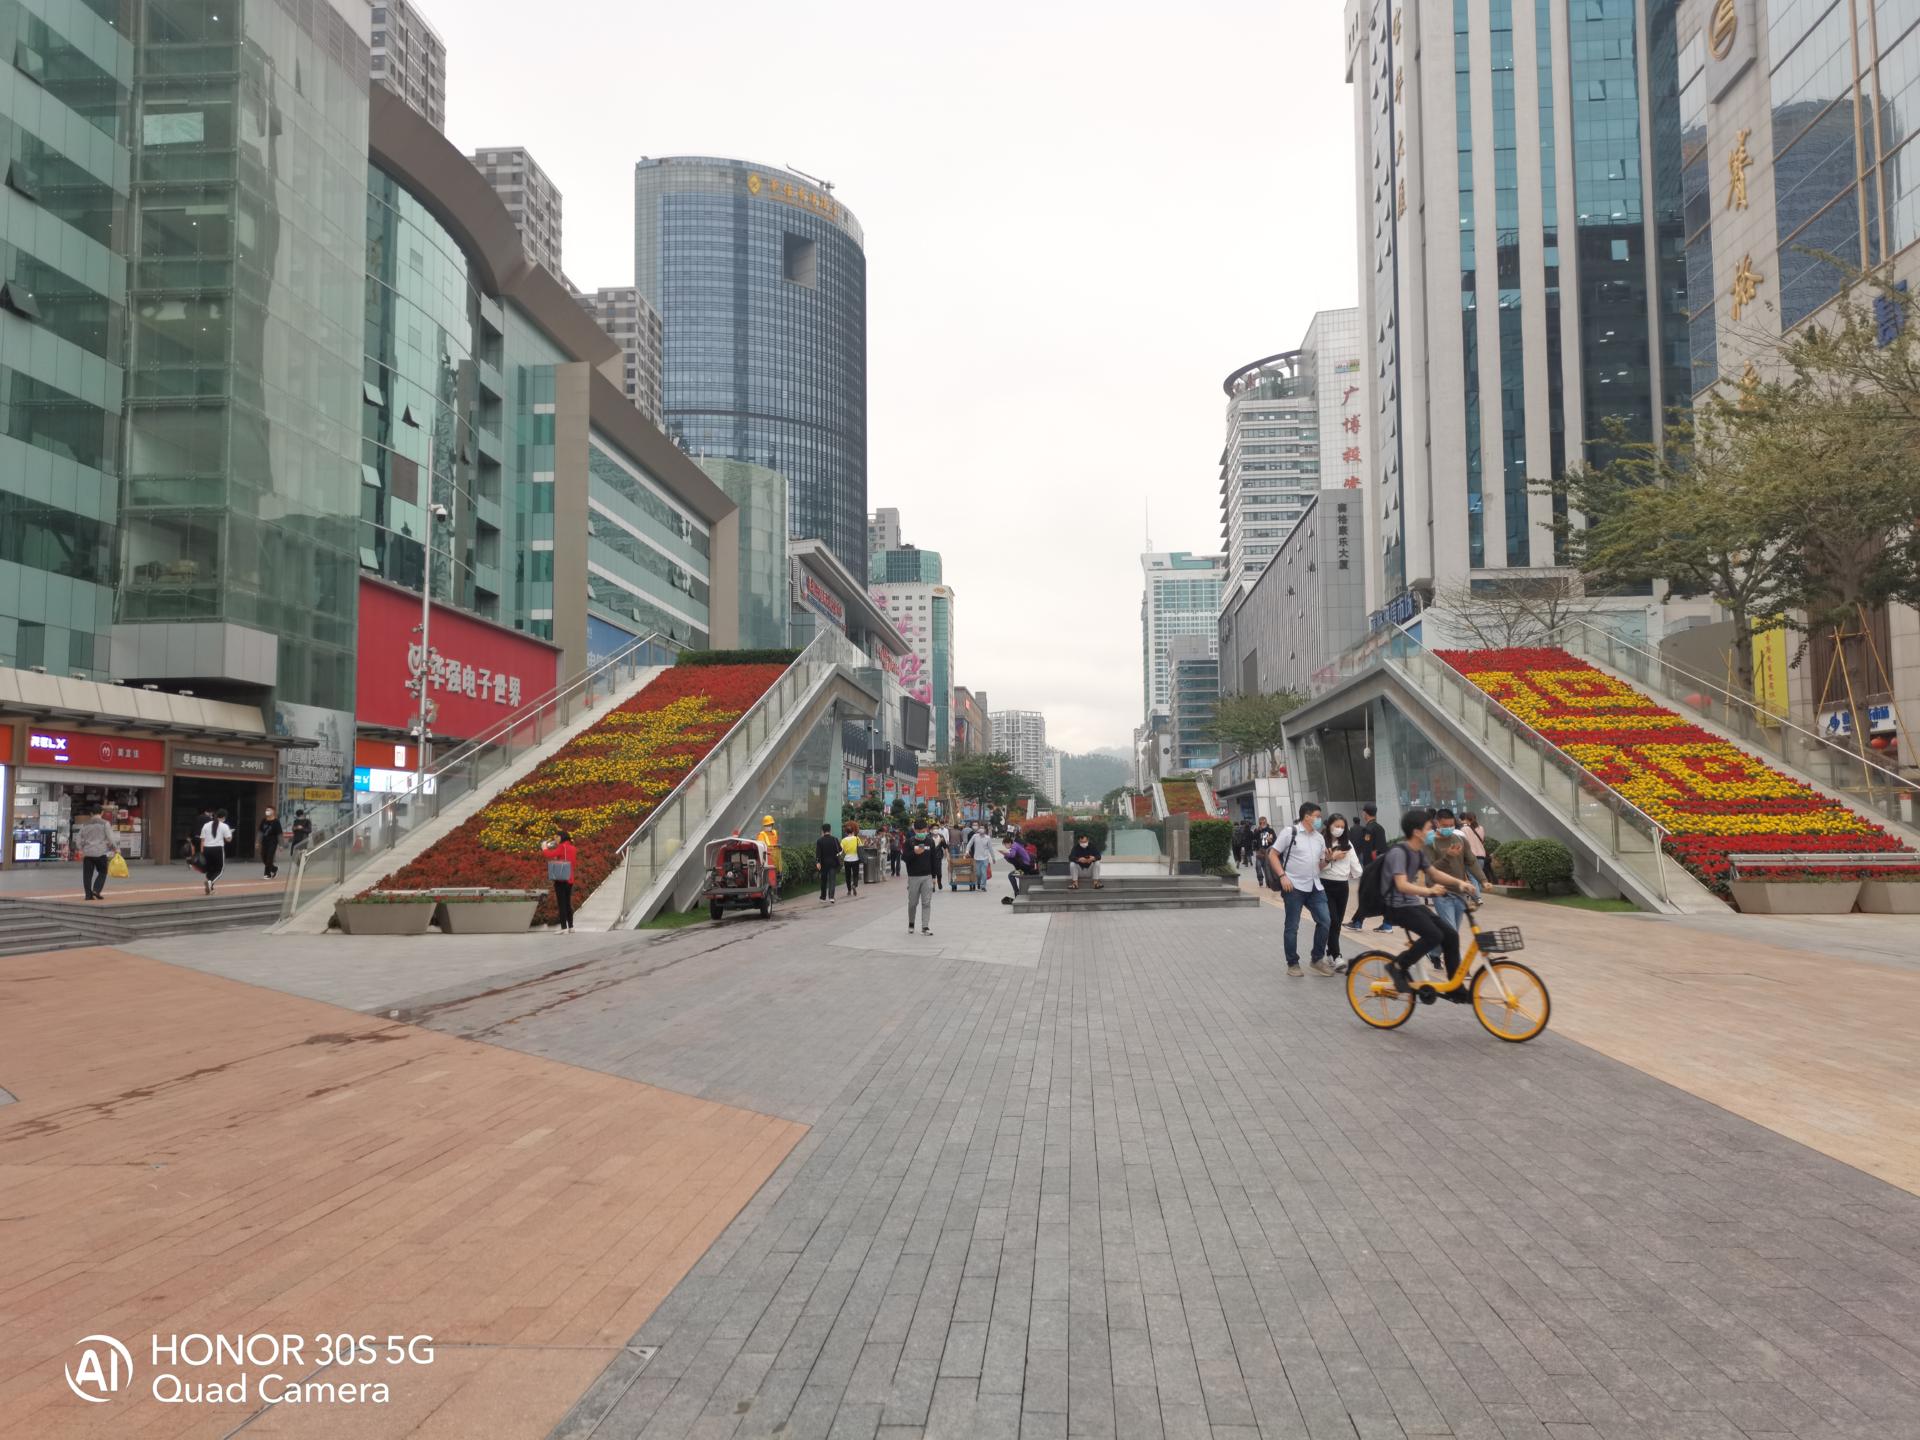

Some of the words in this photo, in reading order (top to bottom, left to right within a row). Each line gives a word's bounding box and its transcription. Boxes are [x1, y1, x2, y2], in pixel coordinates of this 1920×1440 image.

[428, 651, 521, 708] 华强电子世界
[31, 735, 66, 749] RELX
